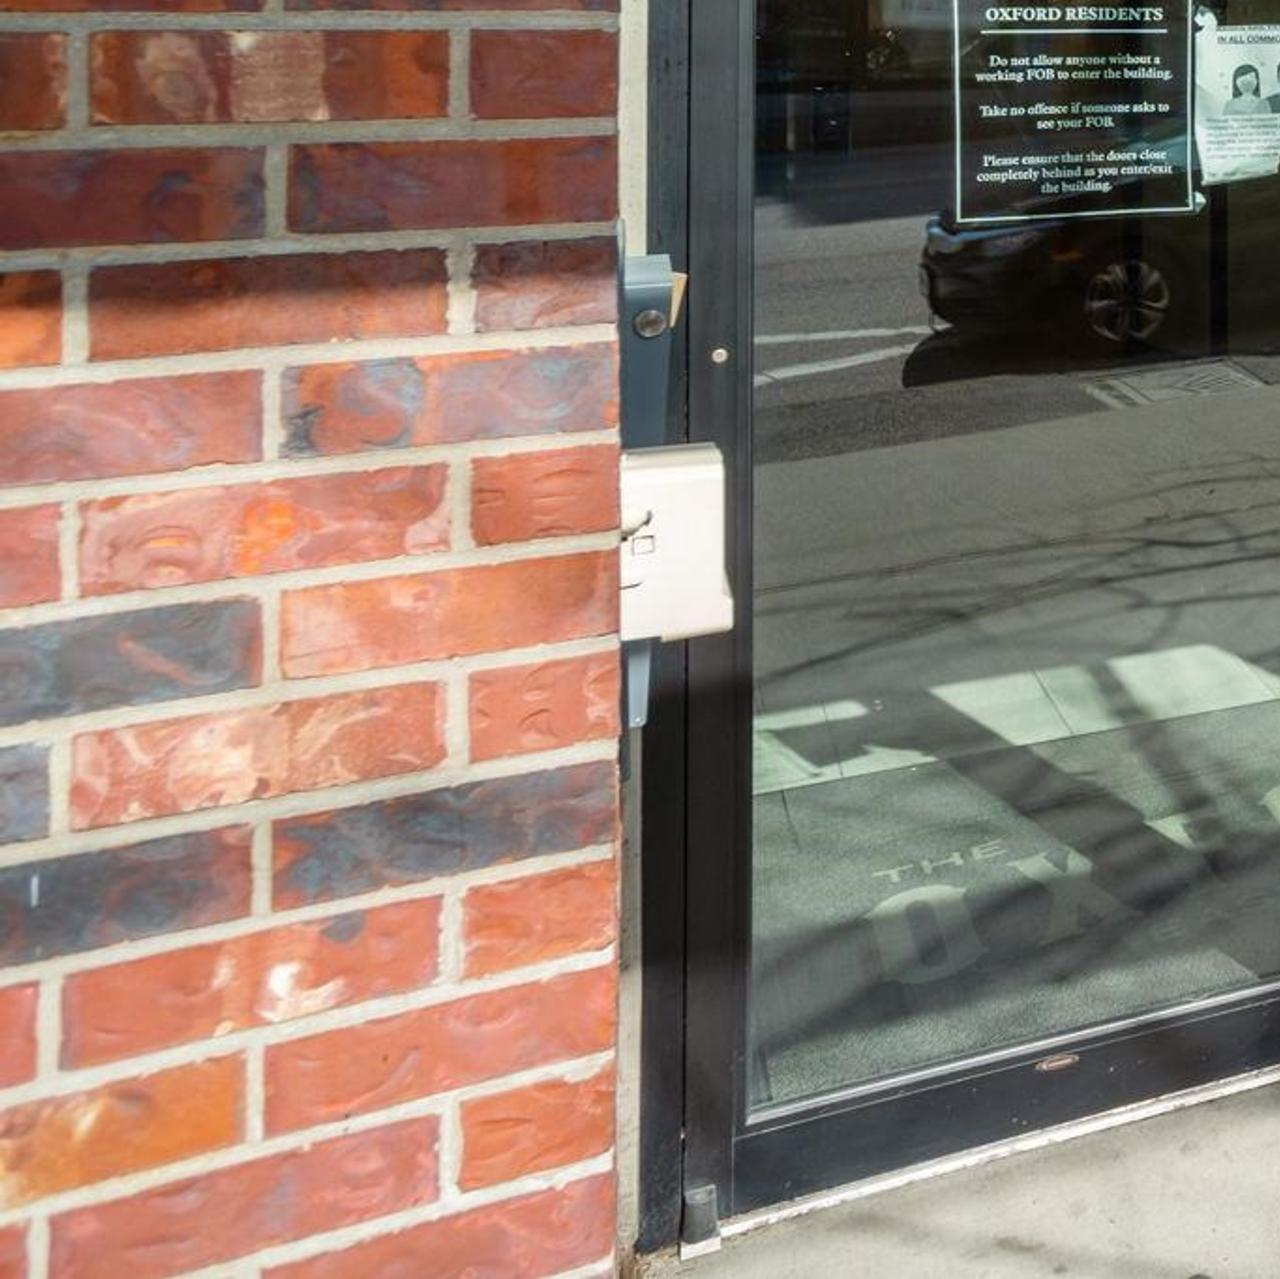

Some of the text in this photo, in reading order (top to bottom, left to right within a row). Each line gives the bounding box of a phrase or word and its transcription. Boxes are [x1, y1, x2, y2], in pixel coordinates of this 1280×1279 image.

[985, 7, 1164, 21] OXFORD RESIDENTS
[1229, 35, 1245, 43] ALL
[989, 53, 1160, 67] Do not allow anyone without a
[975, 67, 1173, 82] working FOB to enter the building.
[979, 102, 1170, 117] Take no offence if someone asks to
[1036, 119, 1056, 129] see
[1056, 119, 1083, 130] your
[982, 149, 1167, 167] Please ensure that the doors close
[976, 163, 1172, 183] completely behind as you enter/exit
[1041, 180, 1113, 193] the building.
[870, 838, 1008, 884] THE
